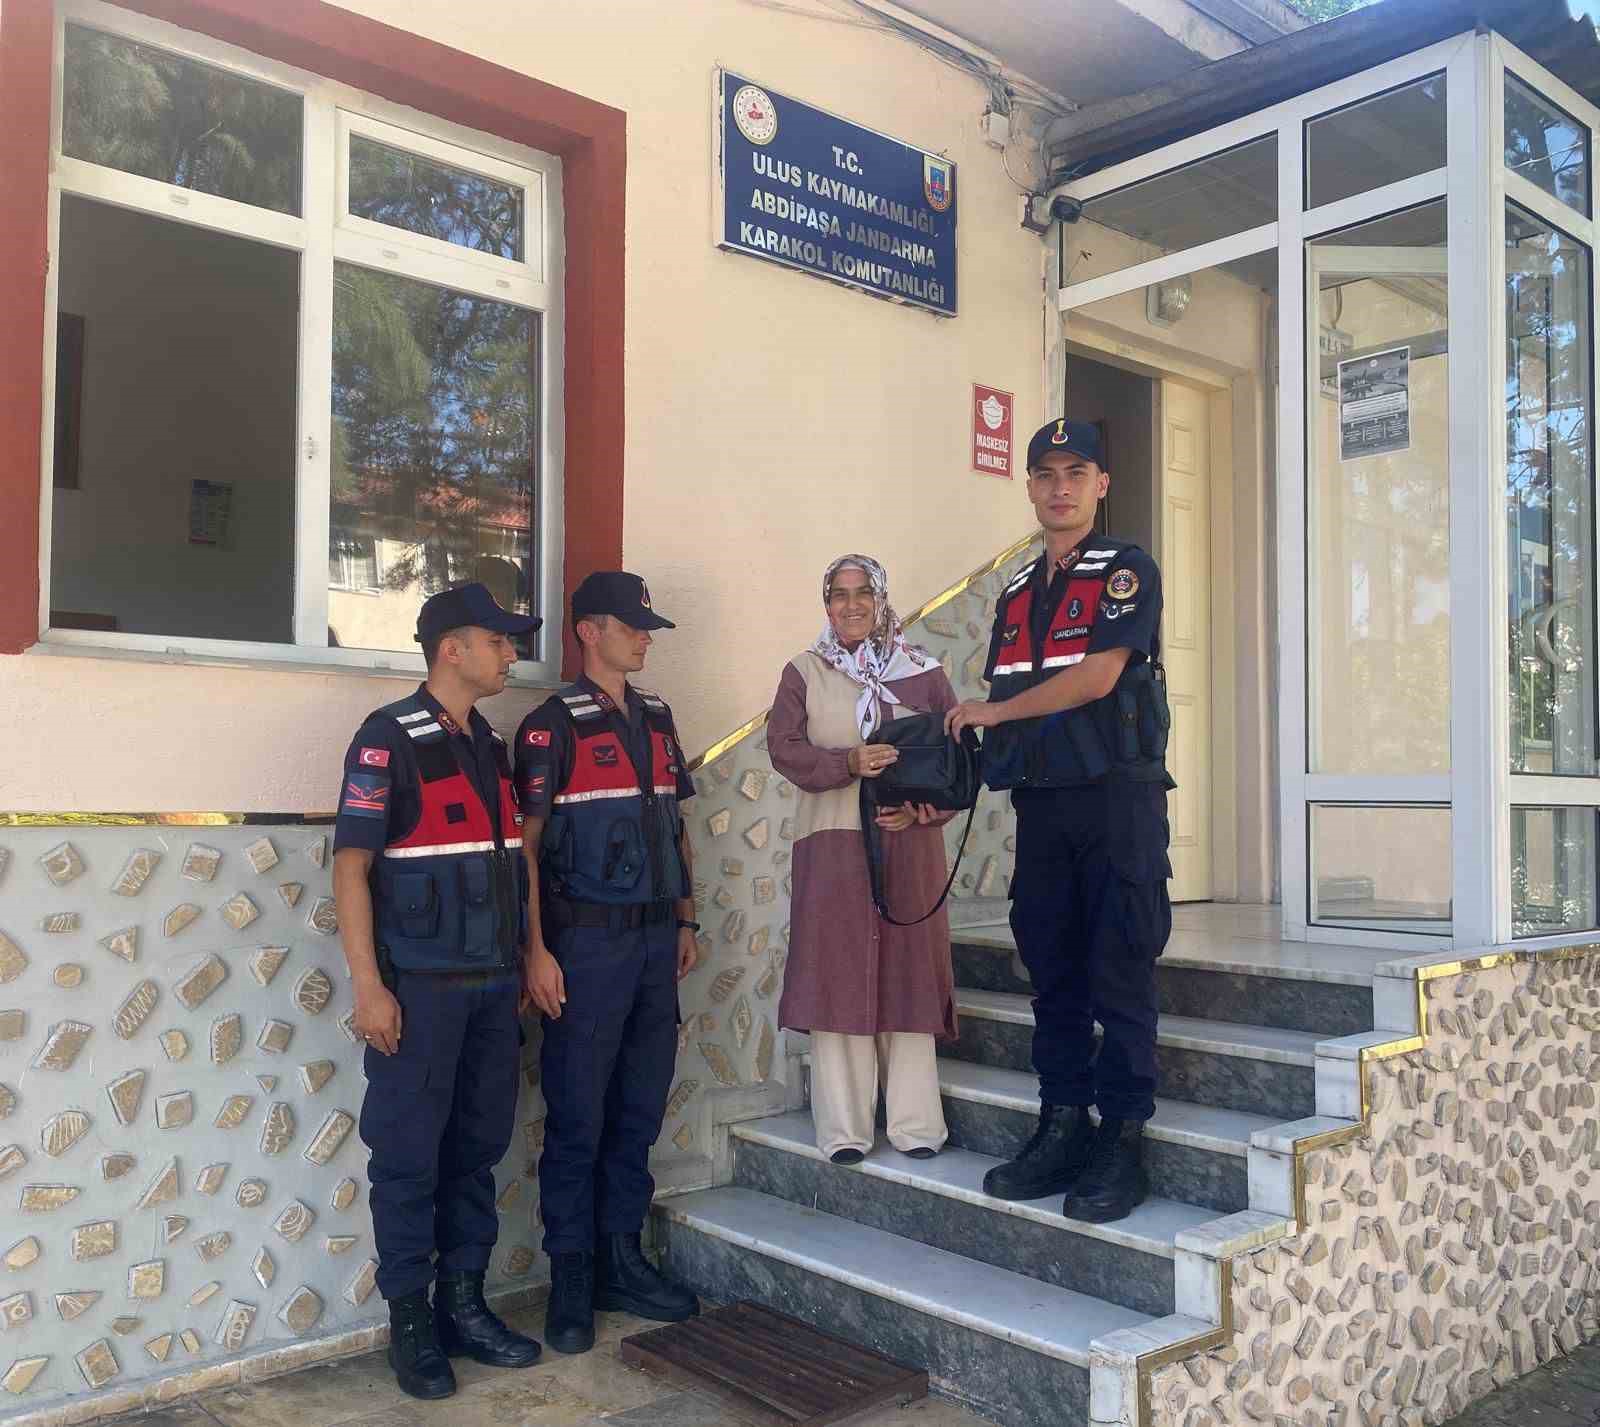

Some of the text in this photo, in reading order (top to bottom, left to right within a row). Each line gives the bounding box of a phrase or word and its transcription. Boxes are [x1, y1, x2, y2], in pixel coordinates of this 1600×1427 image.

[752, 151, 935, 234] ULUS KAYMAKAMLIĞI
[832, 145, 863, 175] T.C.
[740, 221, 945, 304] KARAKOL KOMUTANLIĞI
[751, 188, 936, 269] ABDİPAŞA JANDARMA
[1054, 627, 1088, 640] JANDARMA
